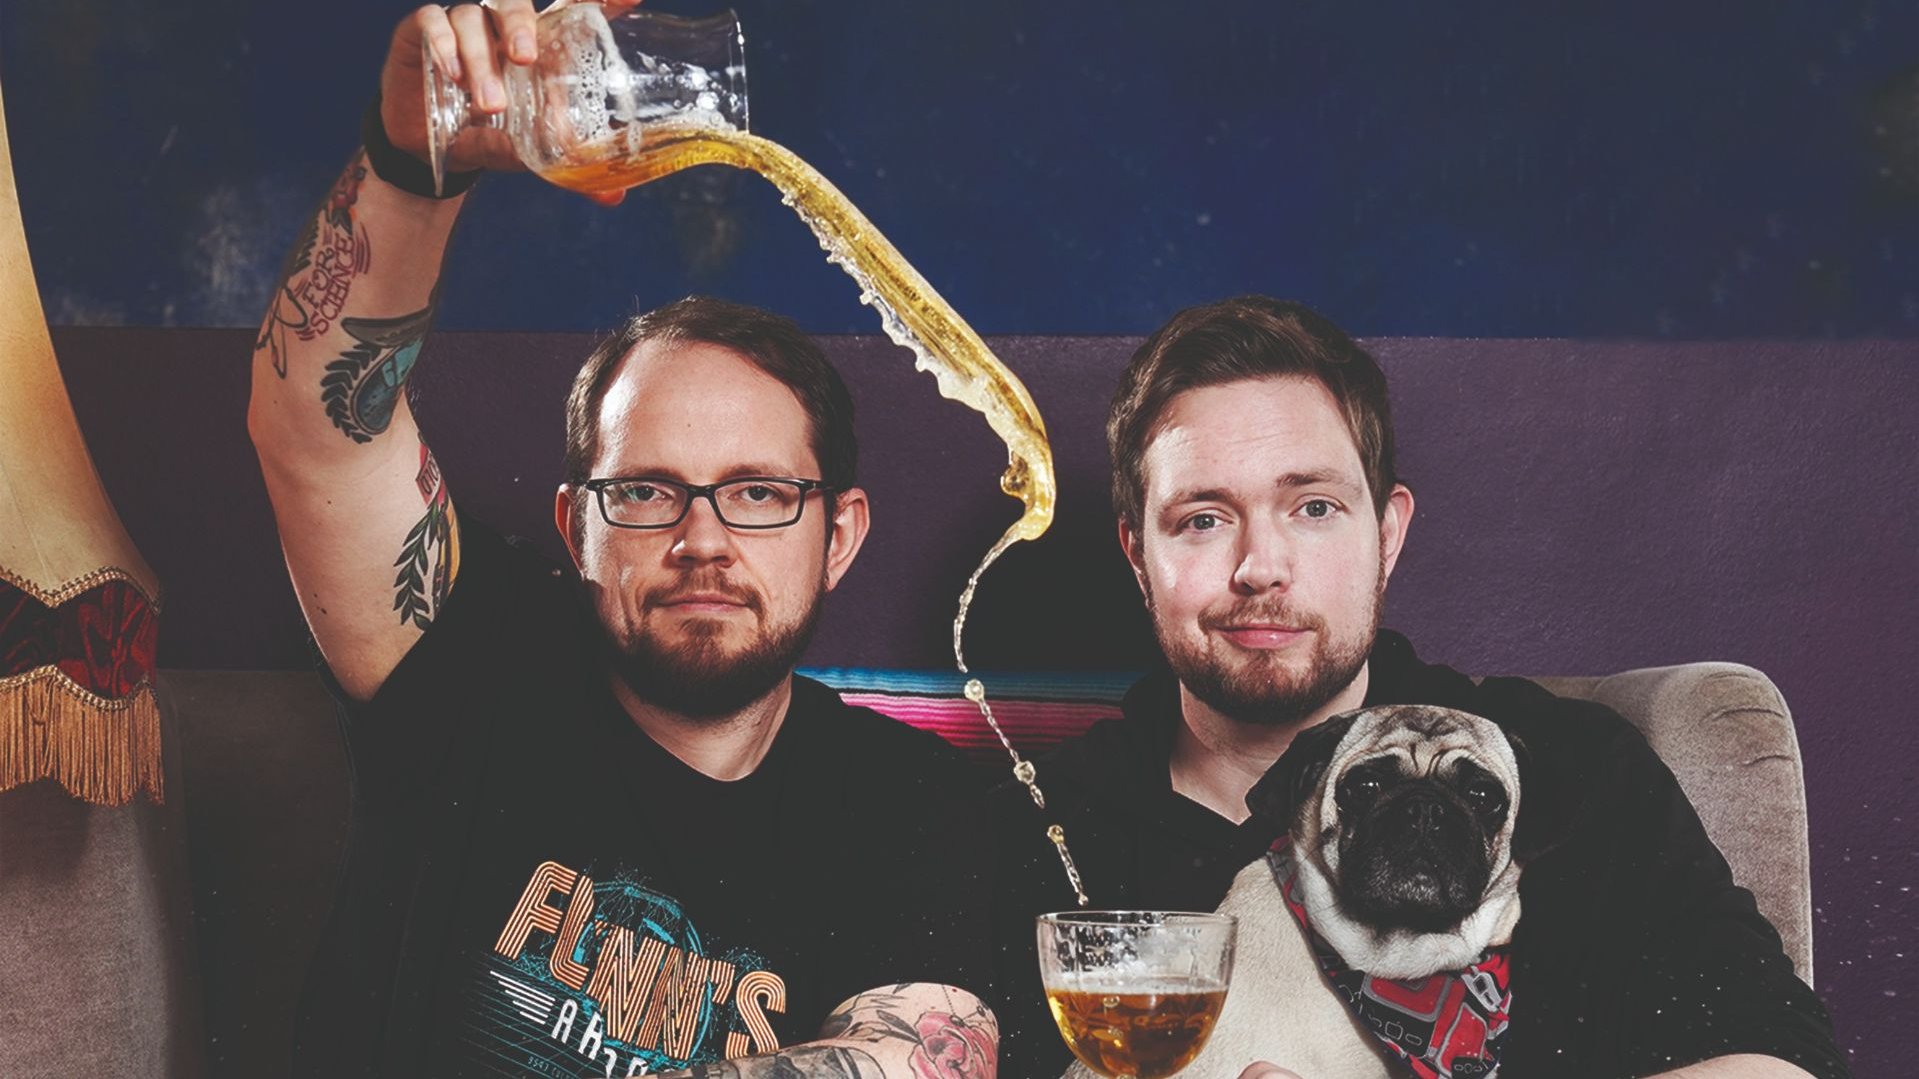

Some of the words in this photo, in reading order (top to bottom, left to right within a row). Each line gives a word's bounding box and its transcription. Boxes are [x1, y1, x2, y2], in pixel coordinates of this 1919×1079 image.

[303, 247, 335, 309] FOR
[310, 232, 354, 335] SCIENCE
[495, 861, 786, 1060] FLNN'S
